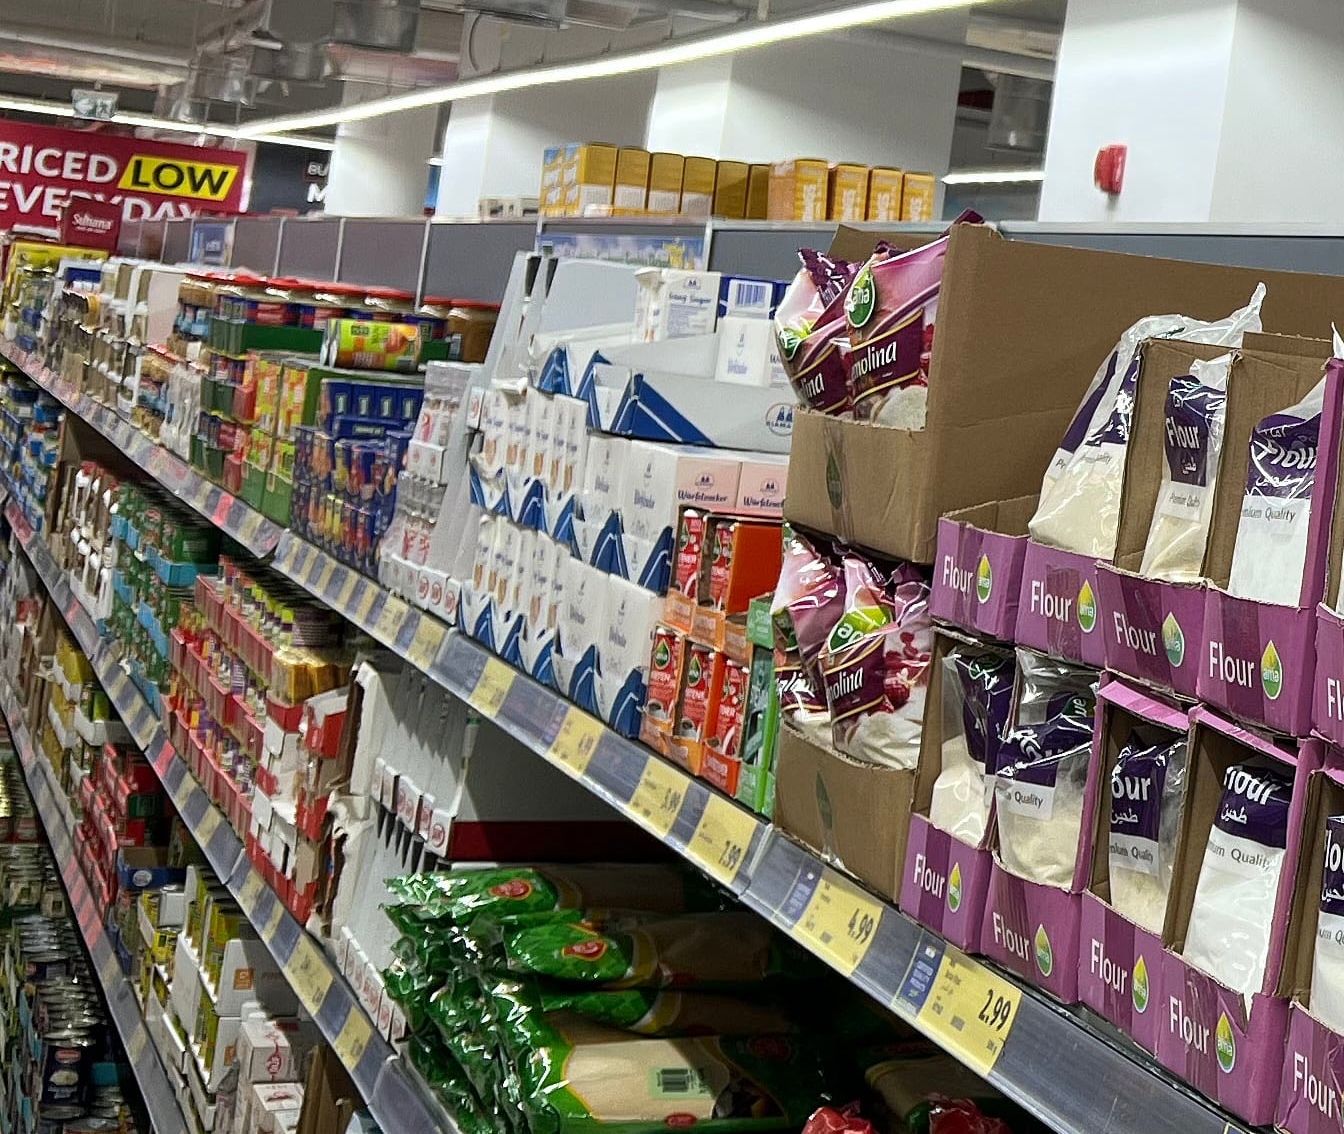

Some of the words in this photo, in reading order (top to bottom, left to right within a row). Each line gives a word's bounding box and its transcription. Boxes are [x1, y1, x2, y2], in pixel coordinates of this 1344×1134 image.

[130, 159, 229, 195] LOW
[1166, 416, 1201, 449] Flour
[1265, 506, 1296, 524] Quality
[942, 555, 974, 595] Flour
[1030, 580, 1073, 623] Flour
[1113, 610, 1157, 657] Flour
[1209, 640, 1256, 688] Flour
[1262, 669, 1280, 683] ama
[1014, 791, 1043, 809] Quality
[1220, 803, 1248, 825] طحين
[913, 853, 946, 899] Flour
[992, 912, 1031, 962] Flour
[1090, 938, 1128, 994] Flour
[978, 988, 1012, 1032] 2.99
[1169, 995, 1210, 1054] Flour
[1293, 1051, 1336, 1118] Flour
